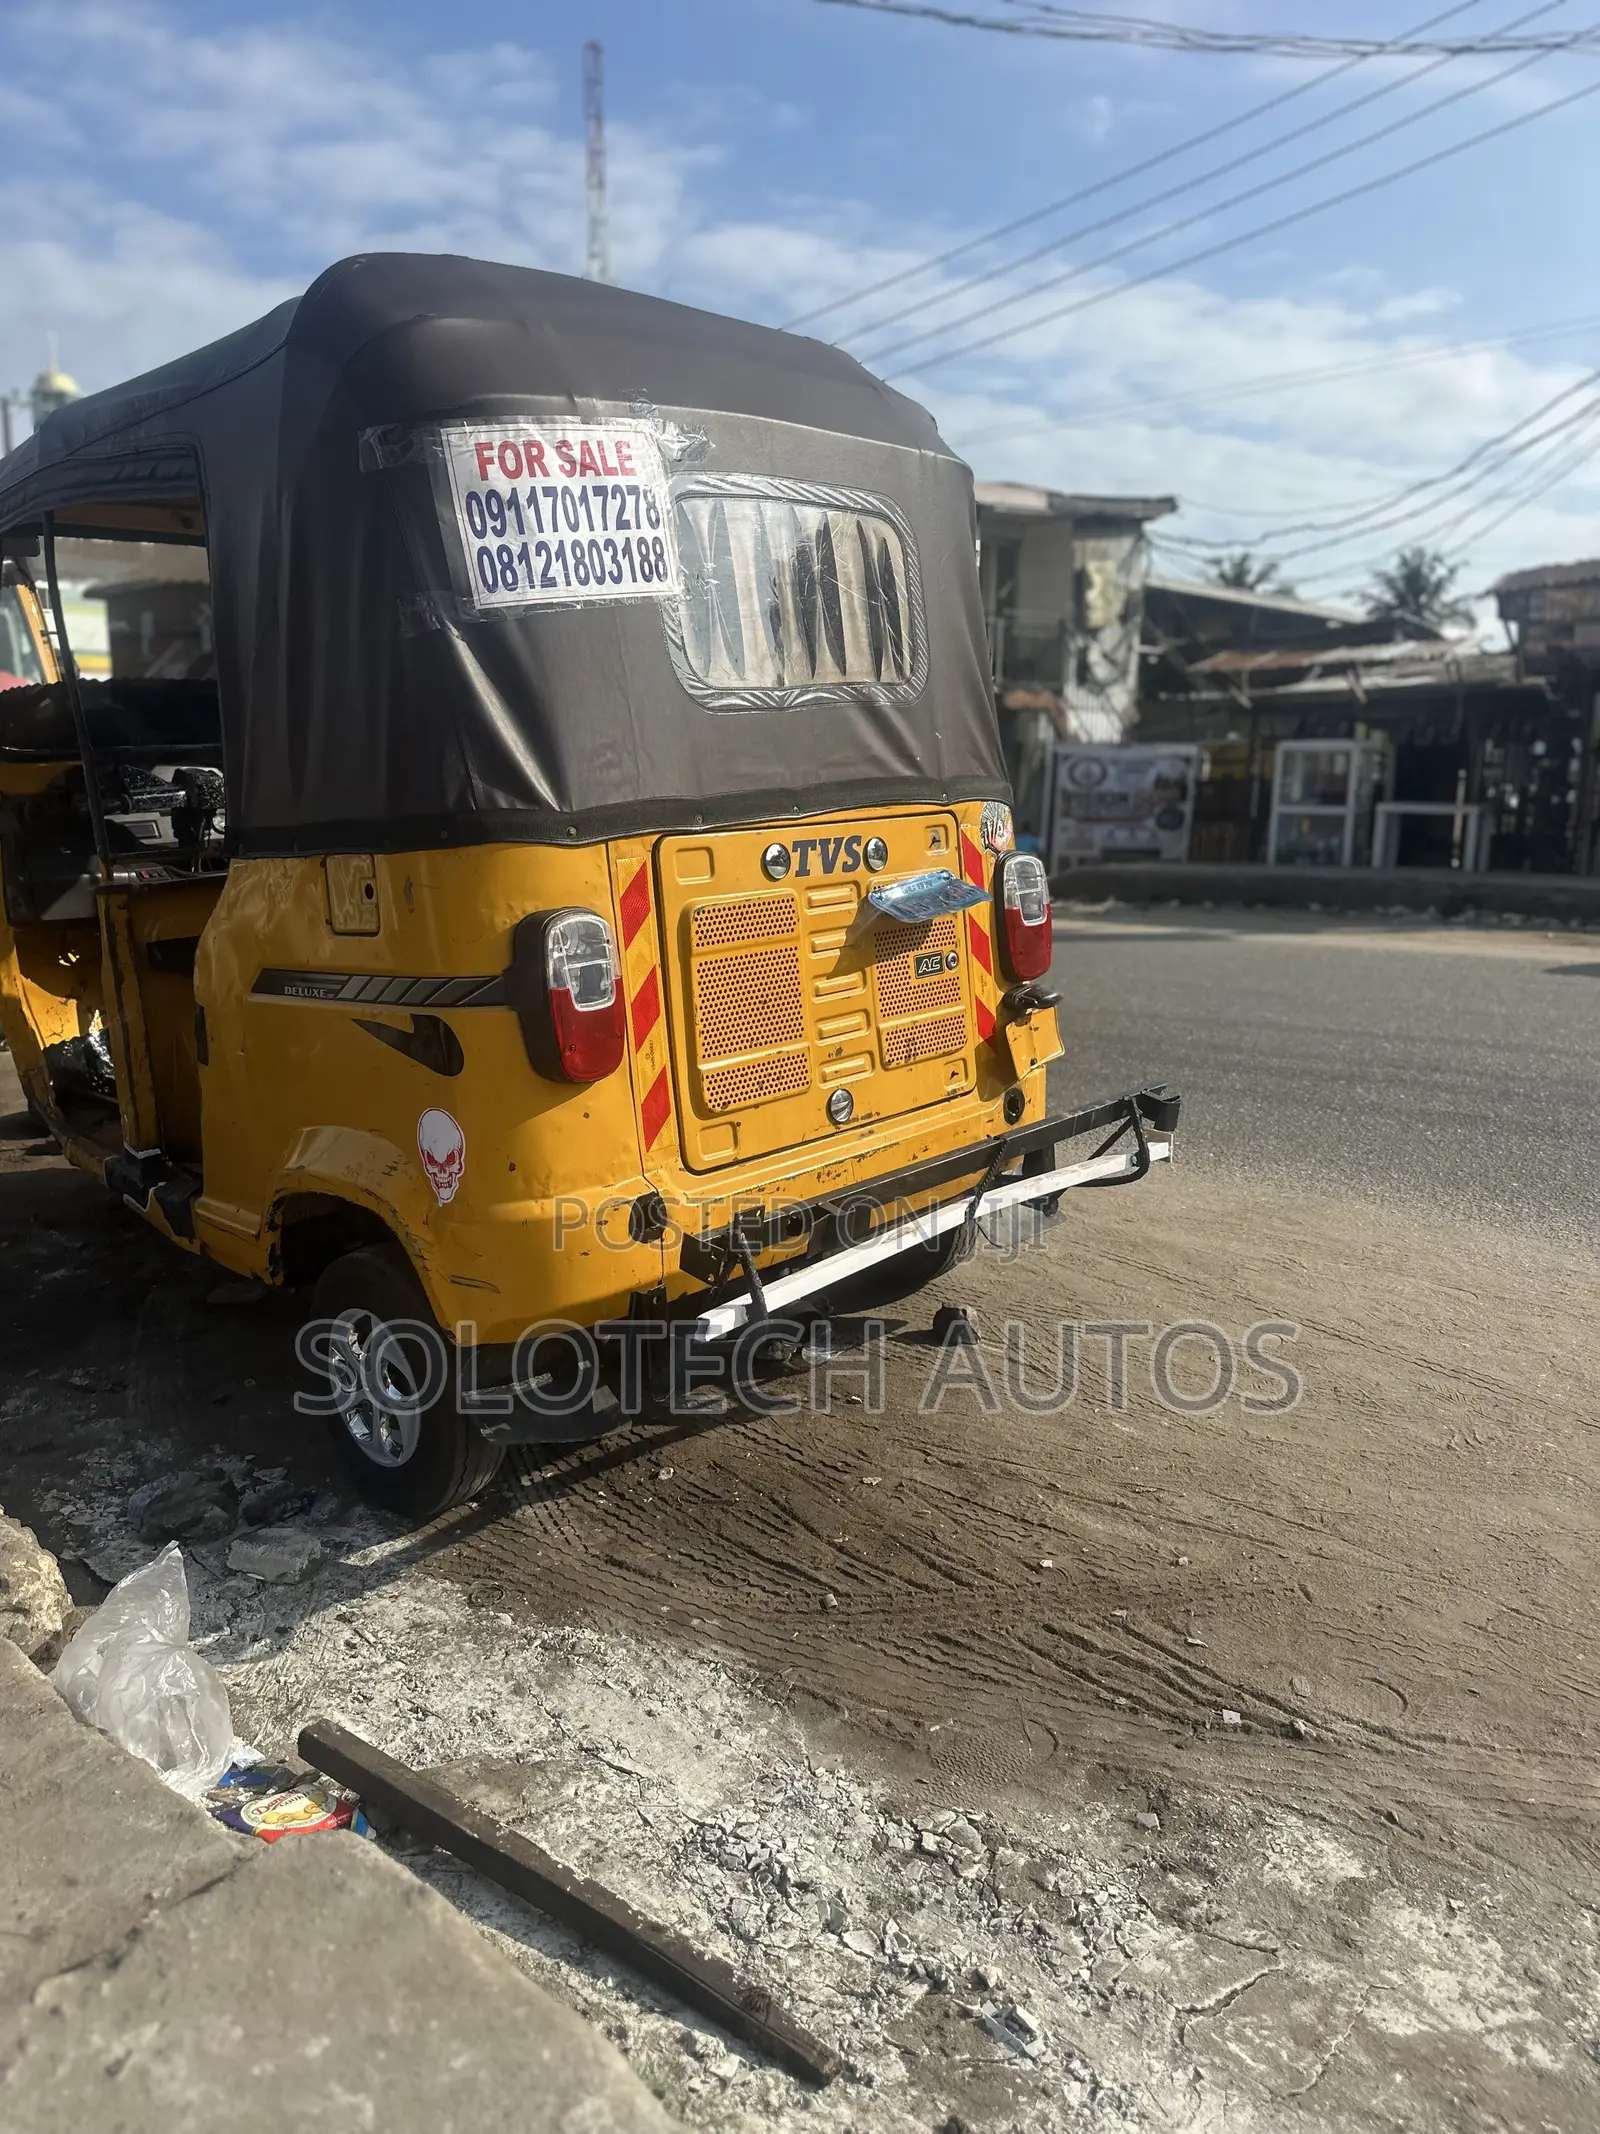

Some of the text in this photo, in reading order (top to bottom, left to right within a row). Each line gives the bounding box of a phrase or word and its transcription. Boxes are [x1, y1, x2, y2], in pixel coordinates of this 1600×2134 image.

[475, 440, 636, 481] FOR SALE
[466, 484, 660, 539] 09117017278
[477, 537, 668, 593] 08121803188
[792, 835, 862, 877] TVS
[918, 956, 941, 974] AC
[285, 986, 326, 998] DELUXE
